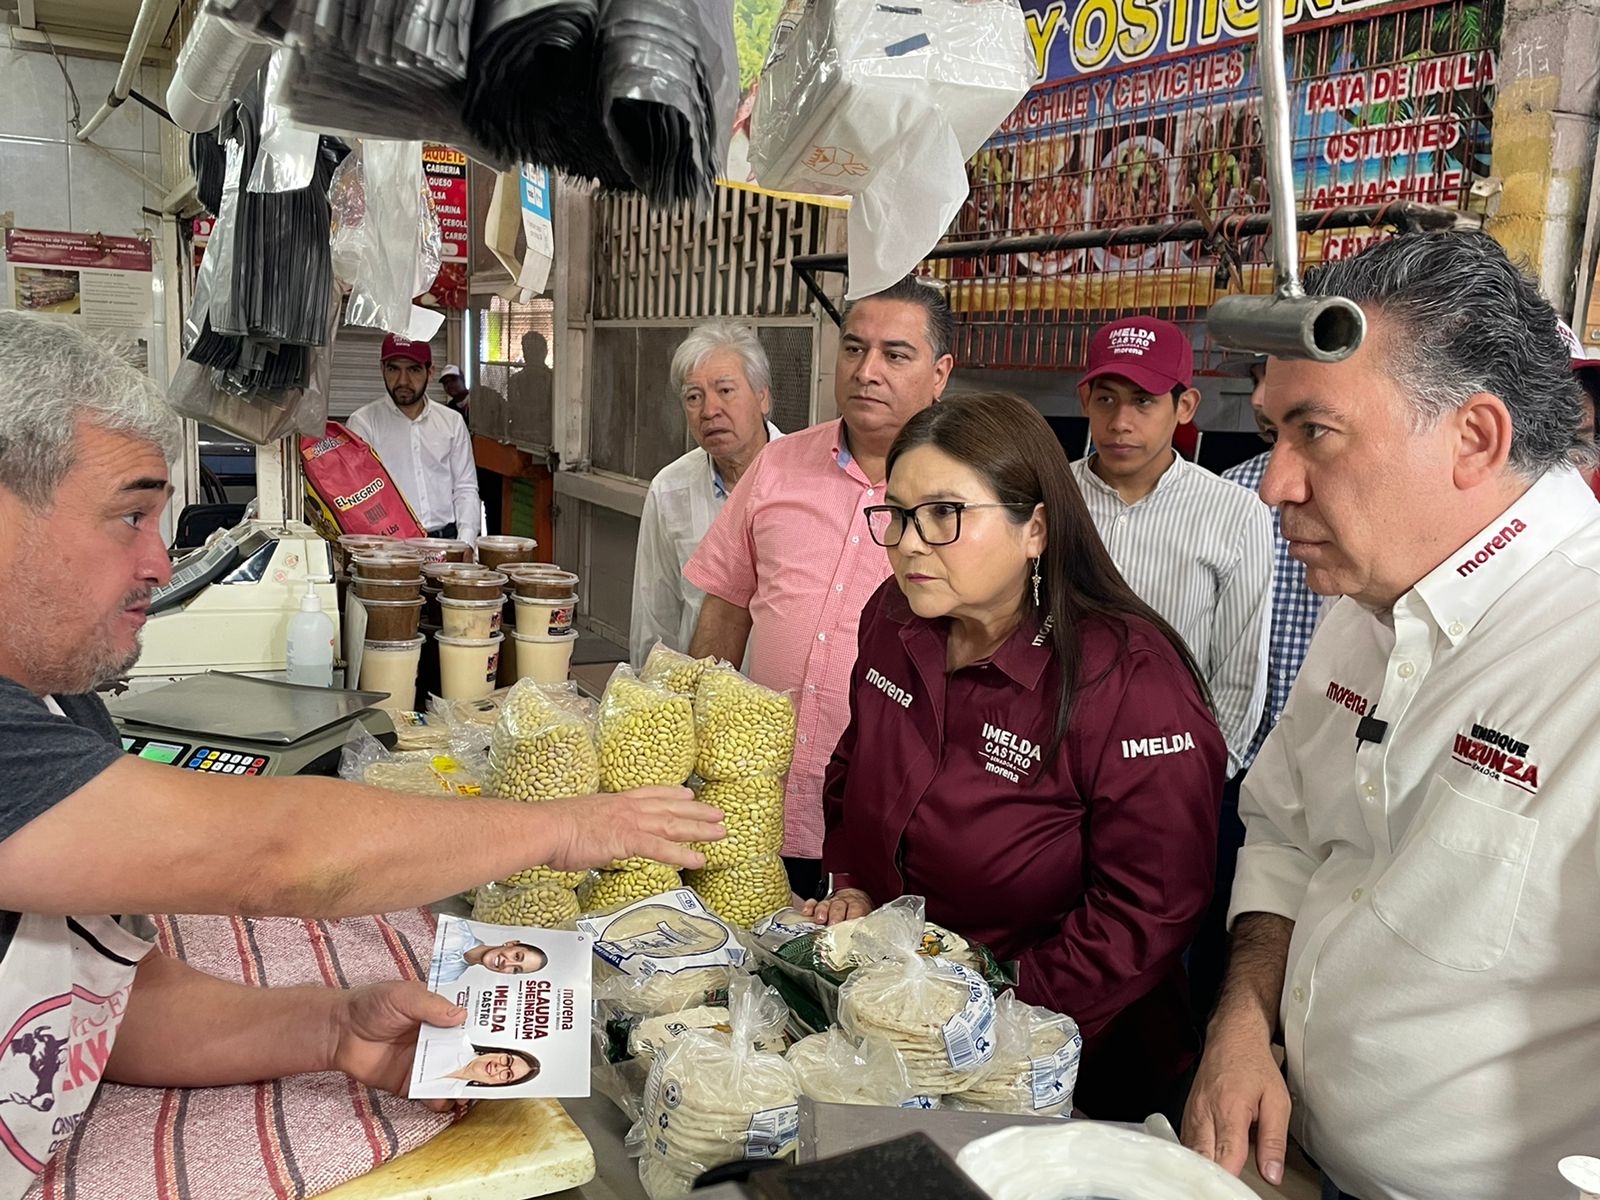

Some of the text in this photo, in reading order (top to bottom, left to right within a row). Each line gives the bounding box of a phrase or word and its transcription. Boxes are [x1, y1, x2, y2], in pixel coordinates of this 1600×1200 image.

[1093, 82, 1111, 108] Y
[1113, 52, 1245, 109] CEVICHES
[1307, 77, 1365, 113] PATA
[1372, 66, 1409, 100] DE
[1415, 52, 1496, 91] MULA
[424, 150, 466, 164] AQUETE
[1325, 117, 1460, 162] OSTIONES
[426, 163, 461, 176] CABRERIA
[429, 177, 453, 188] QUESO
[1311, 172, 1463, 210] AGUACHILE
[442, 218, 468, 229] CEBOLL
[444, 231, 468, 241] CARBO
[1109, 327, 1156, 342] IMELDA
[1111, 337, 1150, 347] CASTRO
[1114, 348, 1143, 356] morena
[334, 478, 384, 509] EL NEGRITO
[1456, 516, 1528, 578] morena
[1031, 611, 1055, 647] more
[864, 667, 914, 709] morena
[1326, 681, 1369, 717] morena
[981, 722, 1041, 762] IMELDA
[985, 741, 1031, 769] CASTRO
[1121, 731, 1196, 759] IMELDA
[1470, 723, 1530, 758] ENRIQUE
[985, 761, 1020, 783] morena
[1453, 733, 1538, 788] INZUNZA
[479, 991, 492, 1027] CASTRO
[490, 985, 509, 1033] IMELDA
[515, 991, 523, 1027] PRESIDENTA
[521, 980, 537, 1040] SHEINBAUM
[533, 980, 551, 1040] CLAUDIA
[561, 988, 574, 1031] morena
